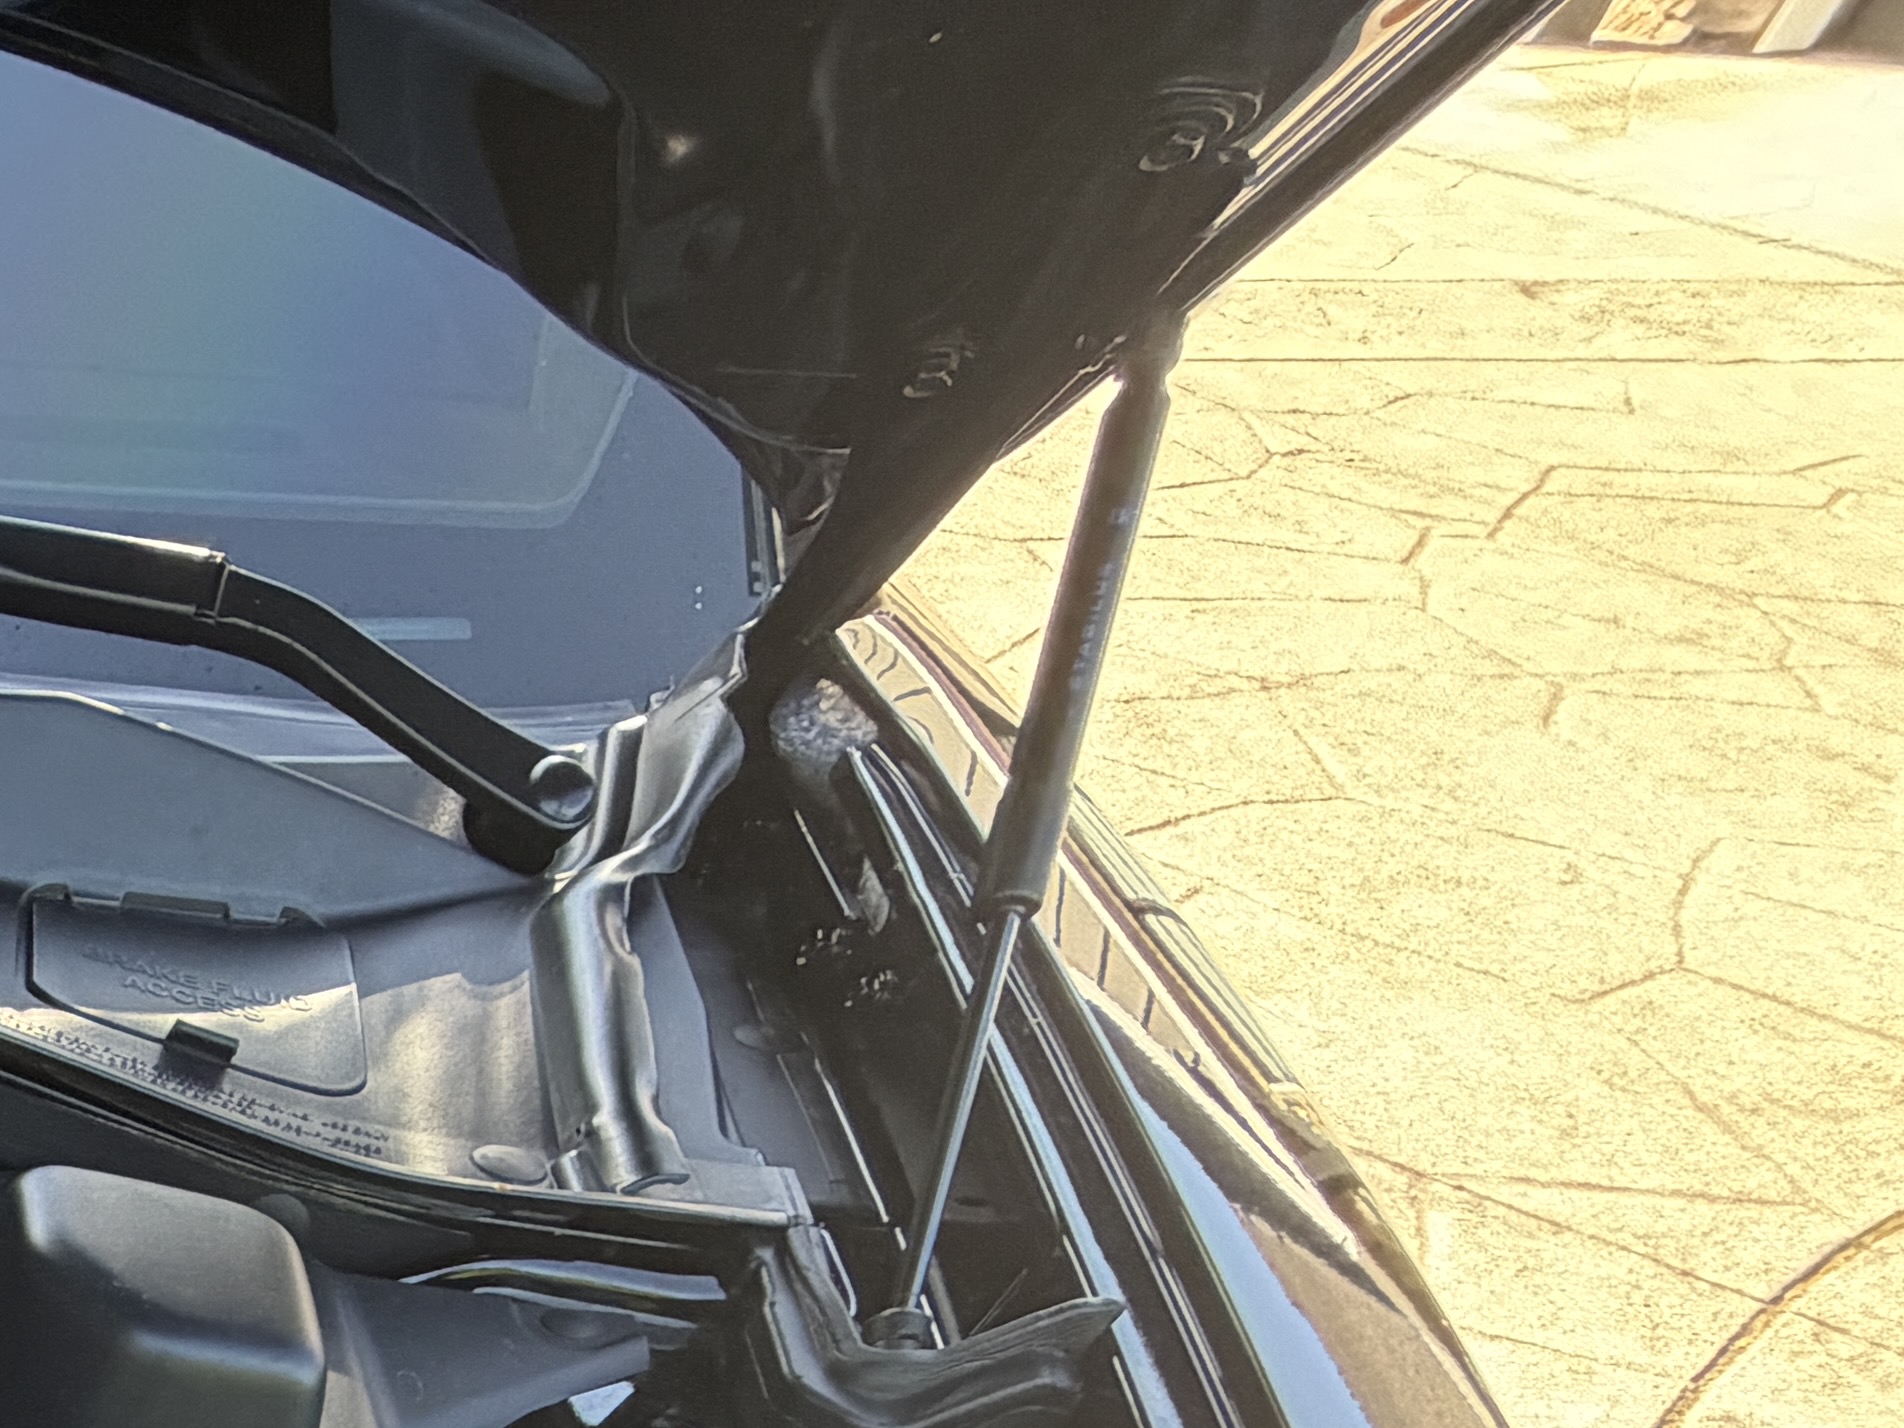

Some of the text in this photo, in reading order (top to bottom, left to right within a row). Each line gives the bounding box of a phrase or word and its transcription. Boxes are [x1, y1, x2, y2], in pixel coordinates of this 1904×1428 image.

[80, 944, 313, 1012] BRAKE FLUID
[122, 976, 266, 1023] ACCESS
